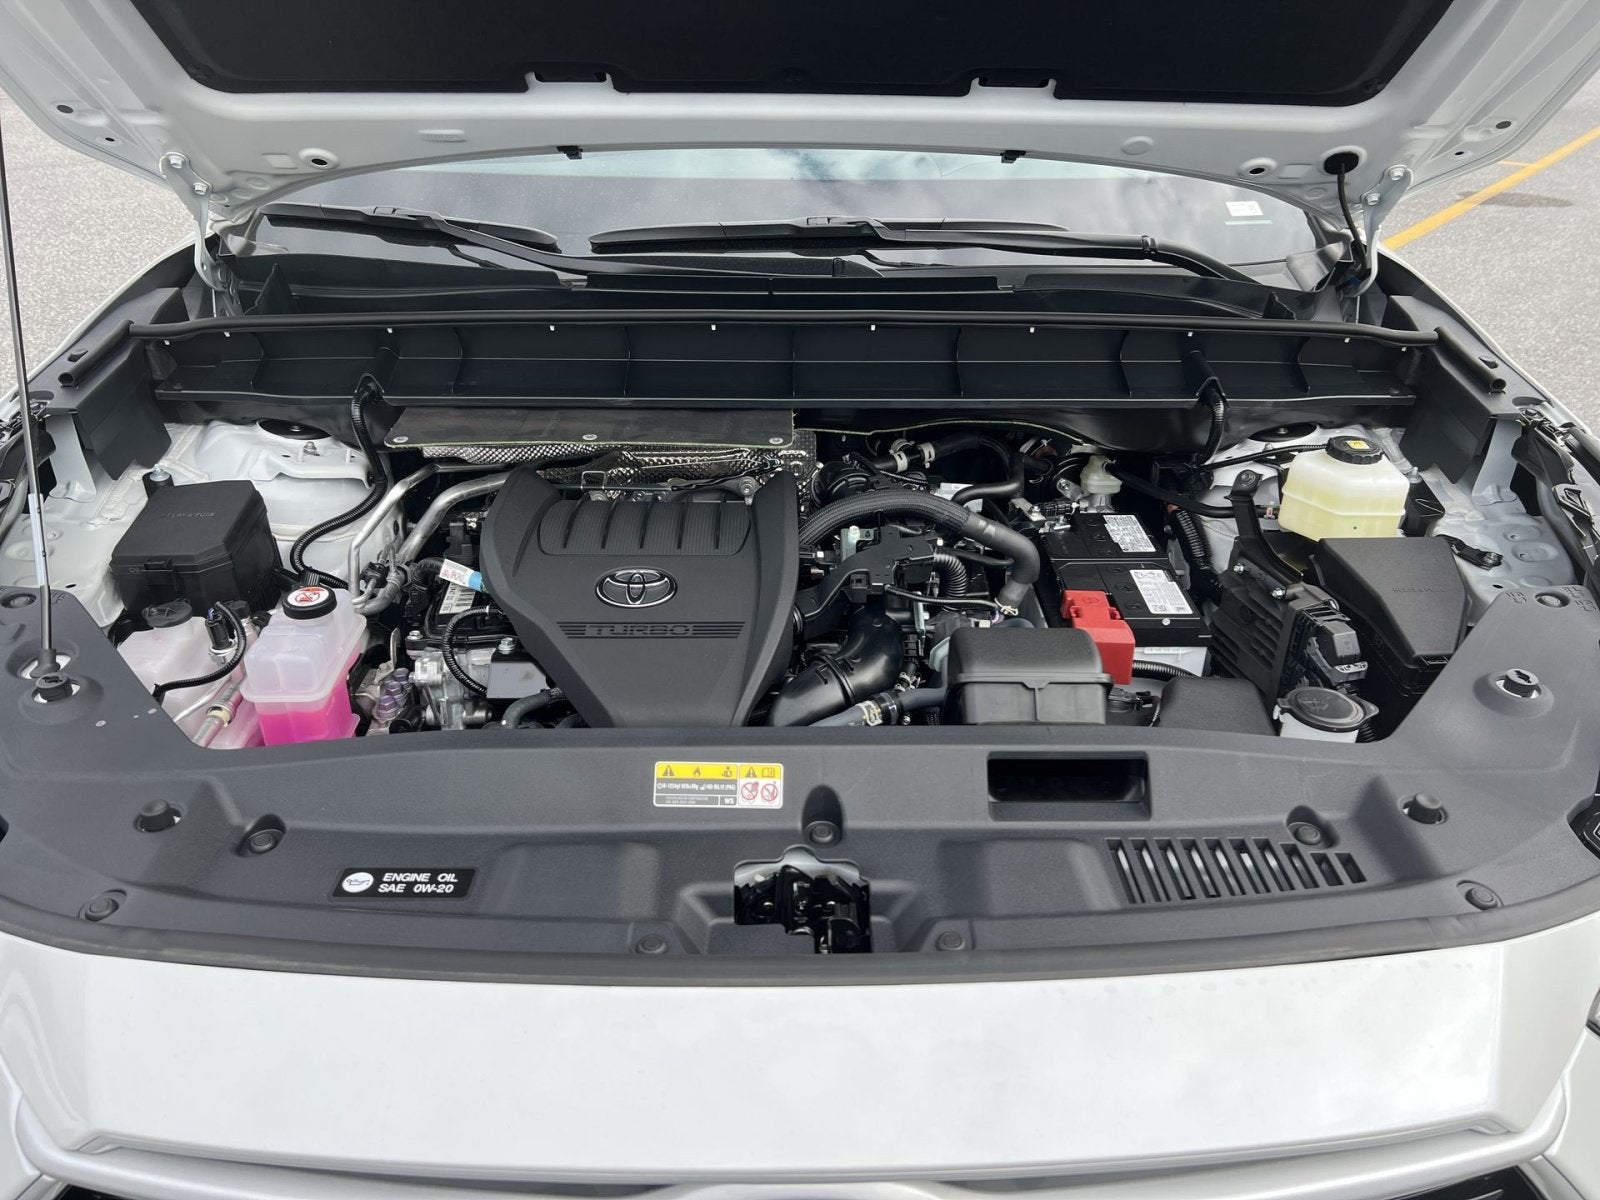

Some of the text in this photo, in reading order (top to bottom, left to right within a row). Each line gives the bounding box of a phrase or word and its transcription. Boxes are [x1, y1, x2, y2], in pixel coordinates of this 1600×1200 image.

[588, 624, 690, 636] TURBO
[382, 872, 458, 883] ENGINE OIL
[378, 883, 455, 893] SAE 0W-20
